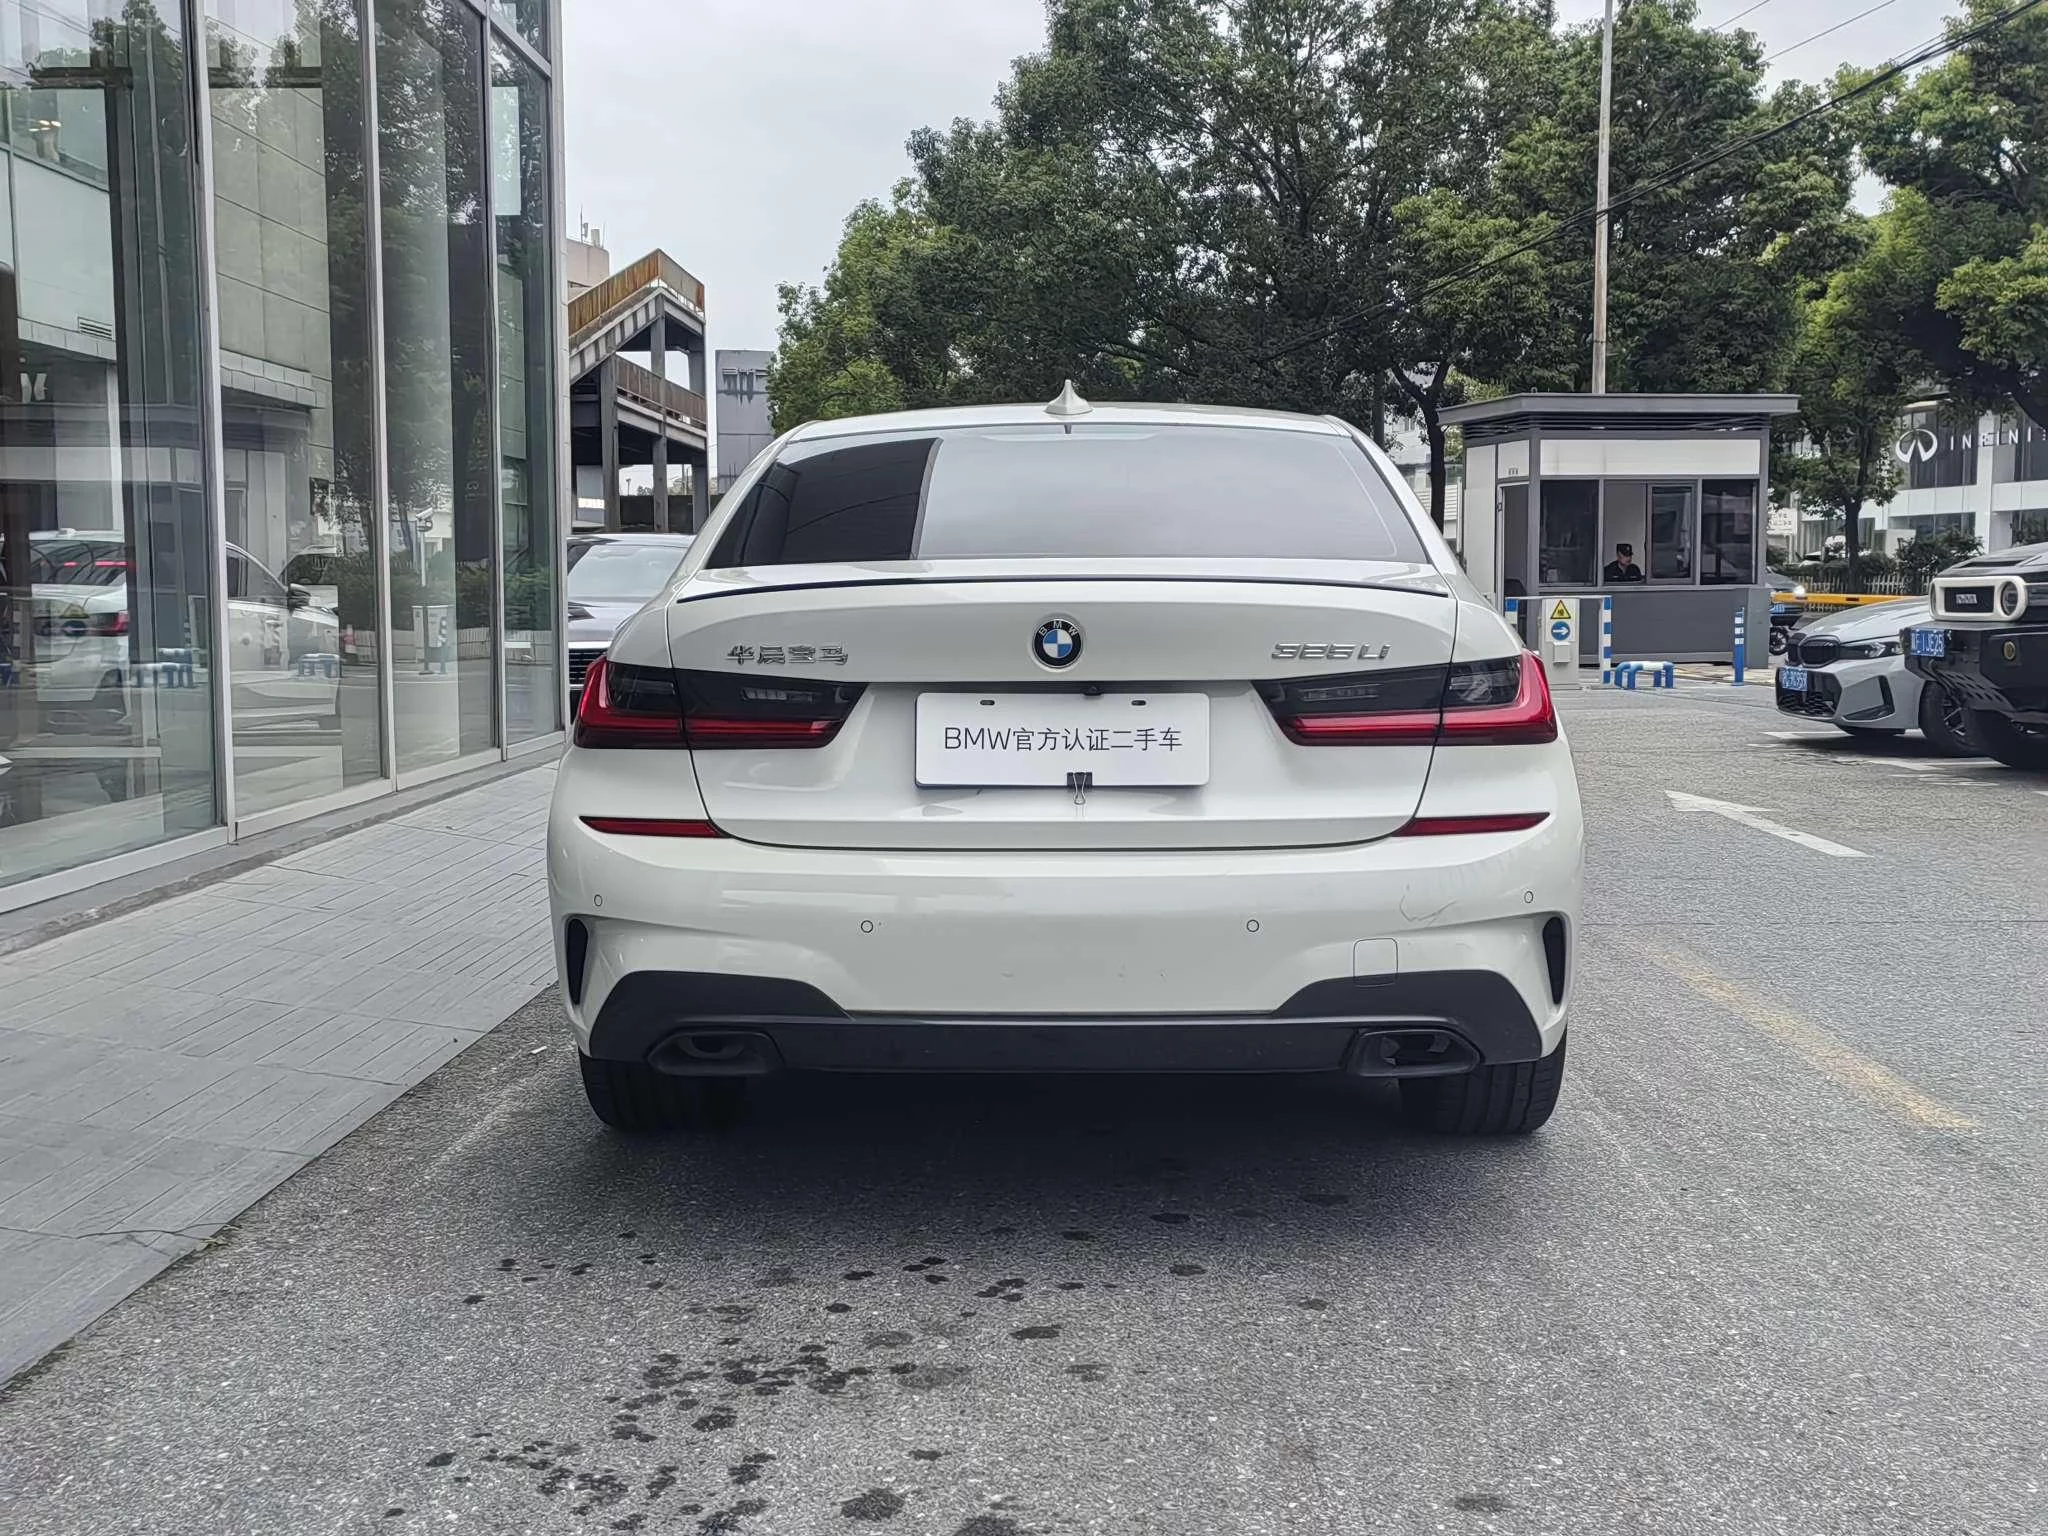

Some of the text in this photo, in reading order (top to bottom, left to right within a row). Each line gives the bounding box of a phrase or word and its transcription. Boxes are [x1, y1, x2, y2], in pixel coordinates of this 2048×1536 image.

[1950, 426, 2048, 451] INFINI
[1038, 619, 1078, 637] BMW
[726, 644, 849, 666] 华晨宝马
[944, 727, 1183, 751] BMW官方认证二手车
